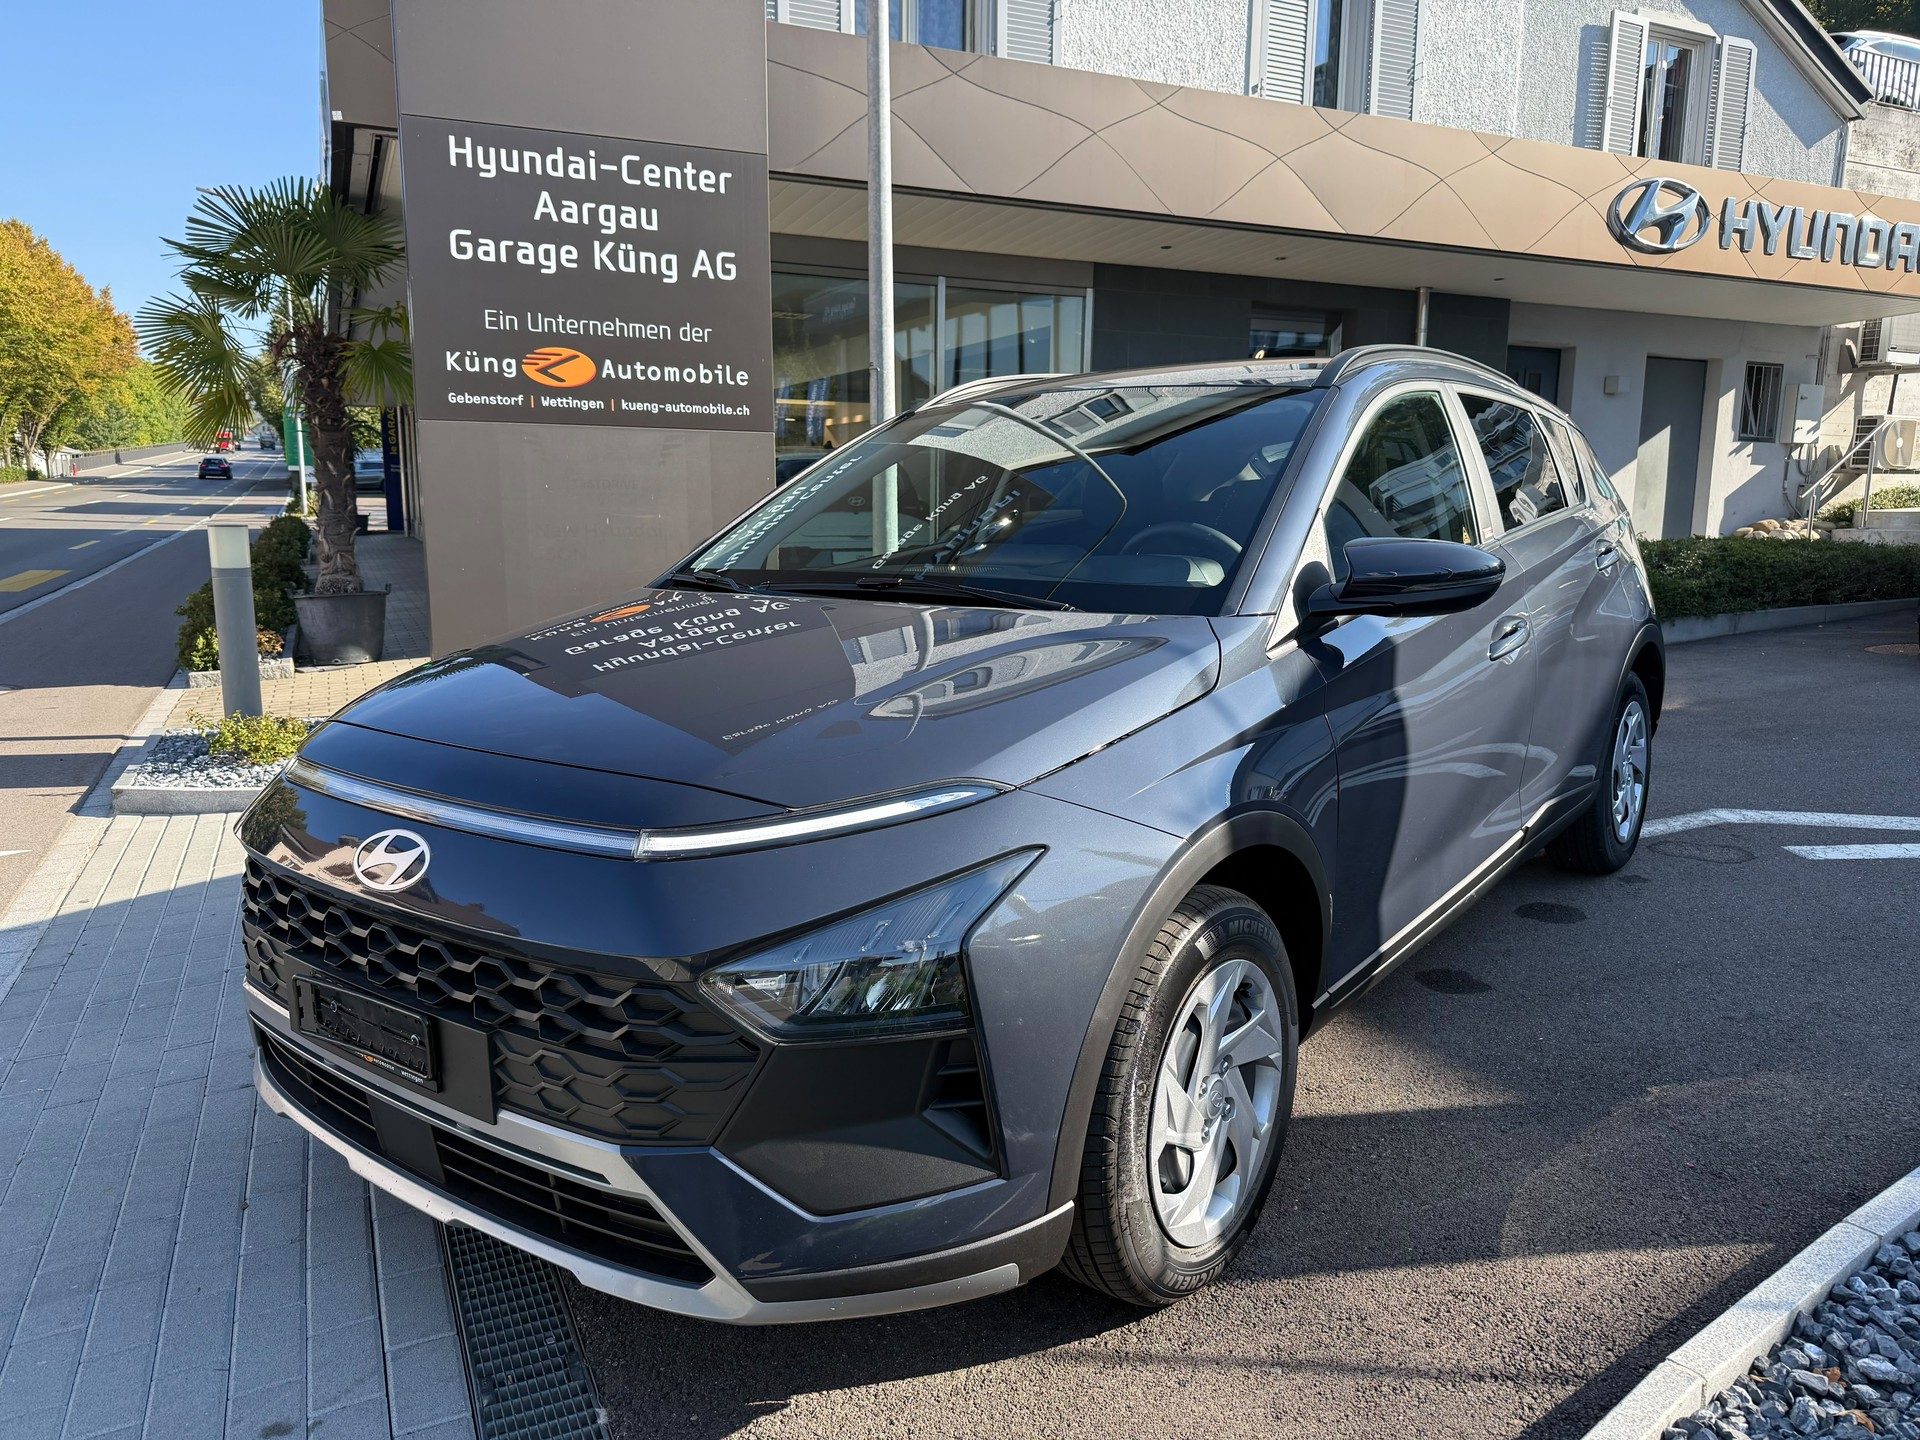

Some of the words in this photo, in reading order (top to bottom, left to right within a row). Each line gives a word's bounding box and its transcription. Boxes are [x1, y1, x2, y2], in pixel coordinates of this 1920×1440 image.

[448, 135, 733, 195] Hyundai-Center
[533, 190, 659, 234] Aargau
[1719, 196, 1920, 273] HYUNDA
[449, 229, 580, 275] Garage
[593, 240, 679, 284] Küng
[691, 249, 738, 281] AG
[484, 309, 519, 332] Ein
[526, 311, 672, 342] Unternehmen
[679, 322, 713, 344] der
[445, 351, 517, 378] Küng
[601, 359, 750, 386] Automobile
[447, 392, 524, 407] Gebenstorf
[540, 396, 605, 411] Wettingen
[621, 399, 751, 416] kueng-automobile.ch
[1228, 919, 1279, 948] MICHELIN
[1163, 1261, 1226, 1290] MICHELIN
